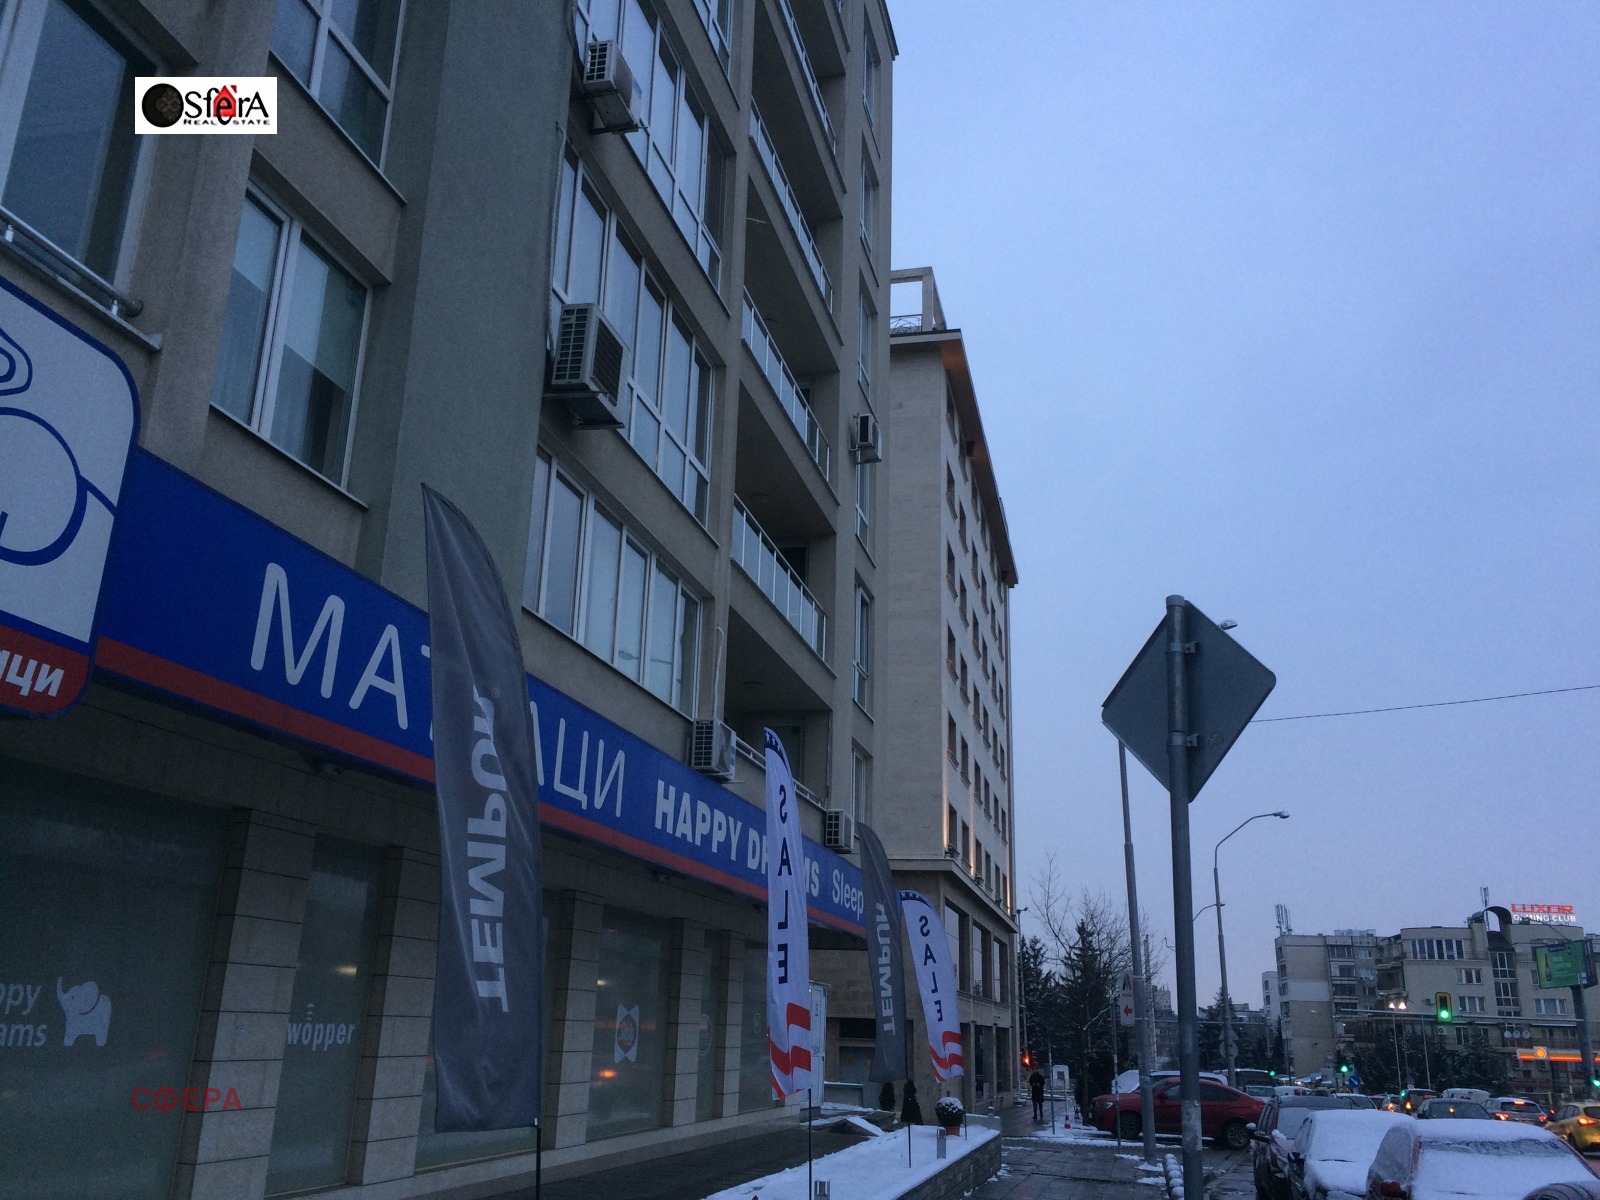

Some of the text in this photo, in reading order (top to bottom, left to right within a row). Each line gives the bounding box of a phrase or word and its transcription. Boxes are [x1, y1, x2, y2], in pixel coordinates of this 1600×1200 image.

[654, 778, 742, 862] HAPPY
[832, 868, 864, 922] Sleep
[1511, 903, 1575, 914] LUXOR
[1551, 914, 1577, 922] CLUB
